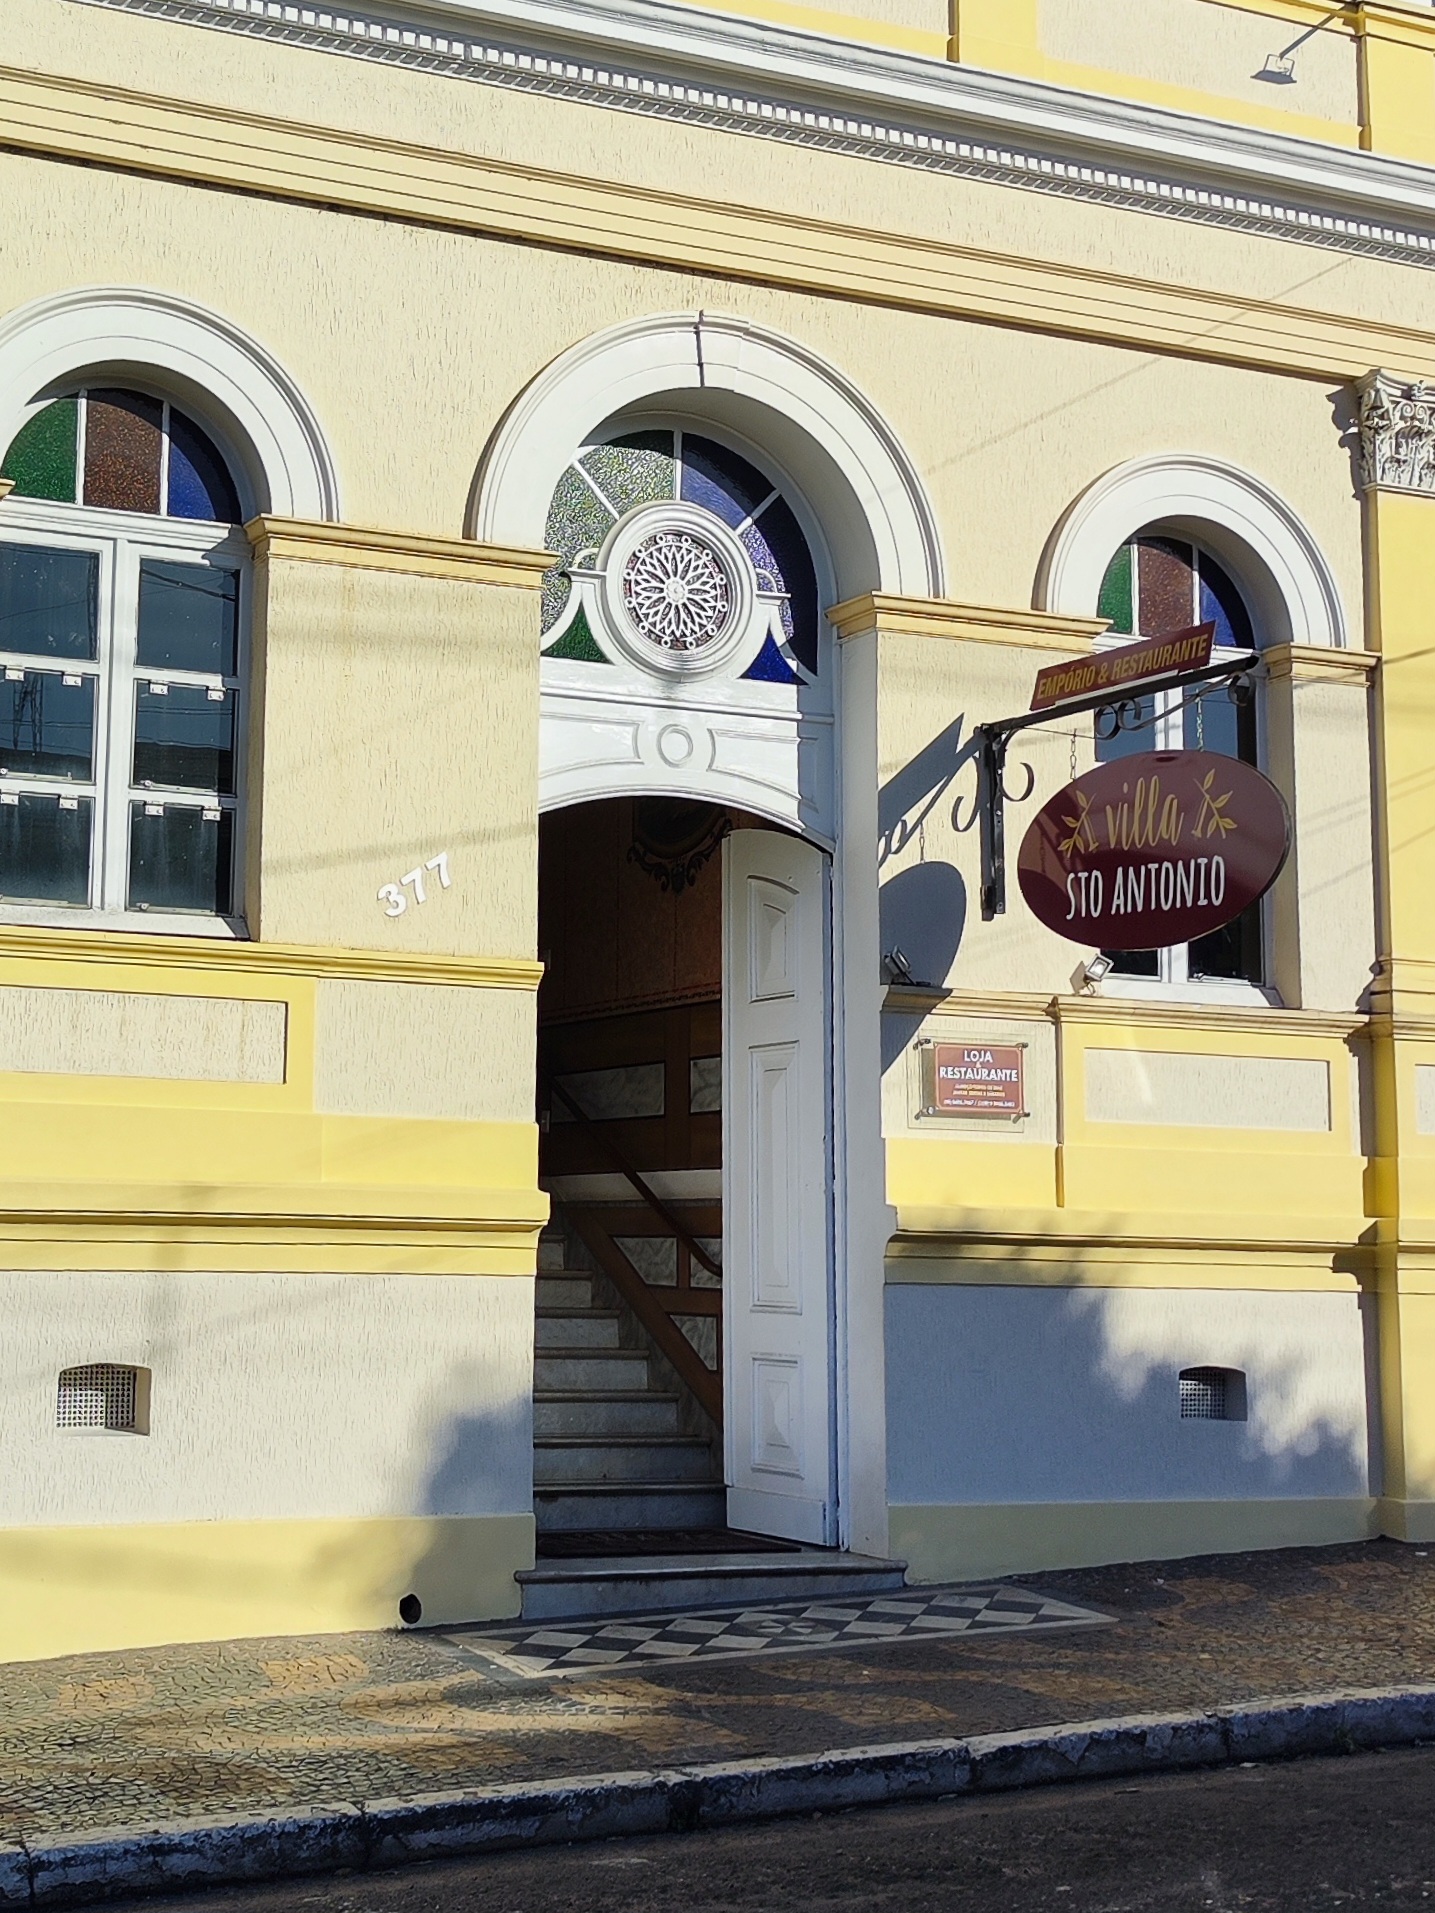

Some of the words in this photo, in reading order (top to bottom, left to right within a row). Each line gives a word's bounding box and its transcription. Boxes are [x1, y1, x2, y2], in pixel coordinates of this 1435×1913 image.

[1037, 666, 1095, 699] EMPÓRIO
[1098, 664, 1109, 686] &
[1112, 634, 1208, 679] RESTAURANTE
[1105, 775, 1185, 851] villa
[376, 851, 452, 918] 377
[1066, 870, 1103, 920] STO
[1111, 855, 1225, 915] ANTONIO
[940, 1067, 1018, 1081] RESTAURANTE
[964, 1050, 993, 1062] LOJA
